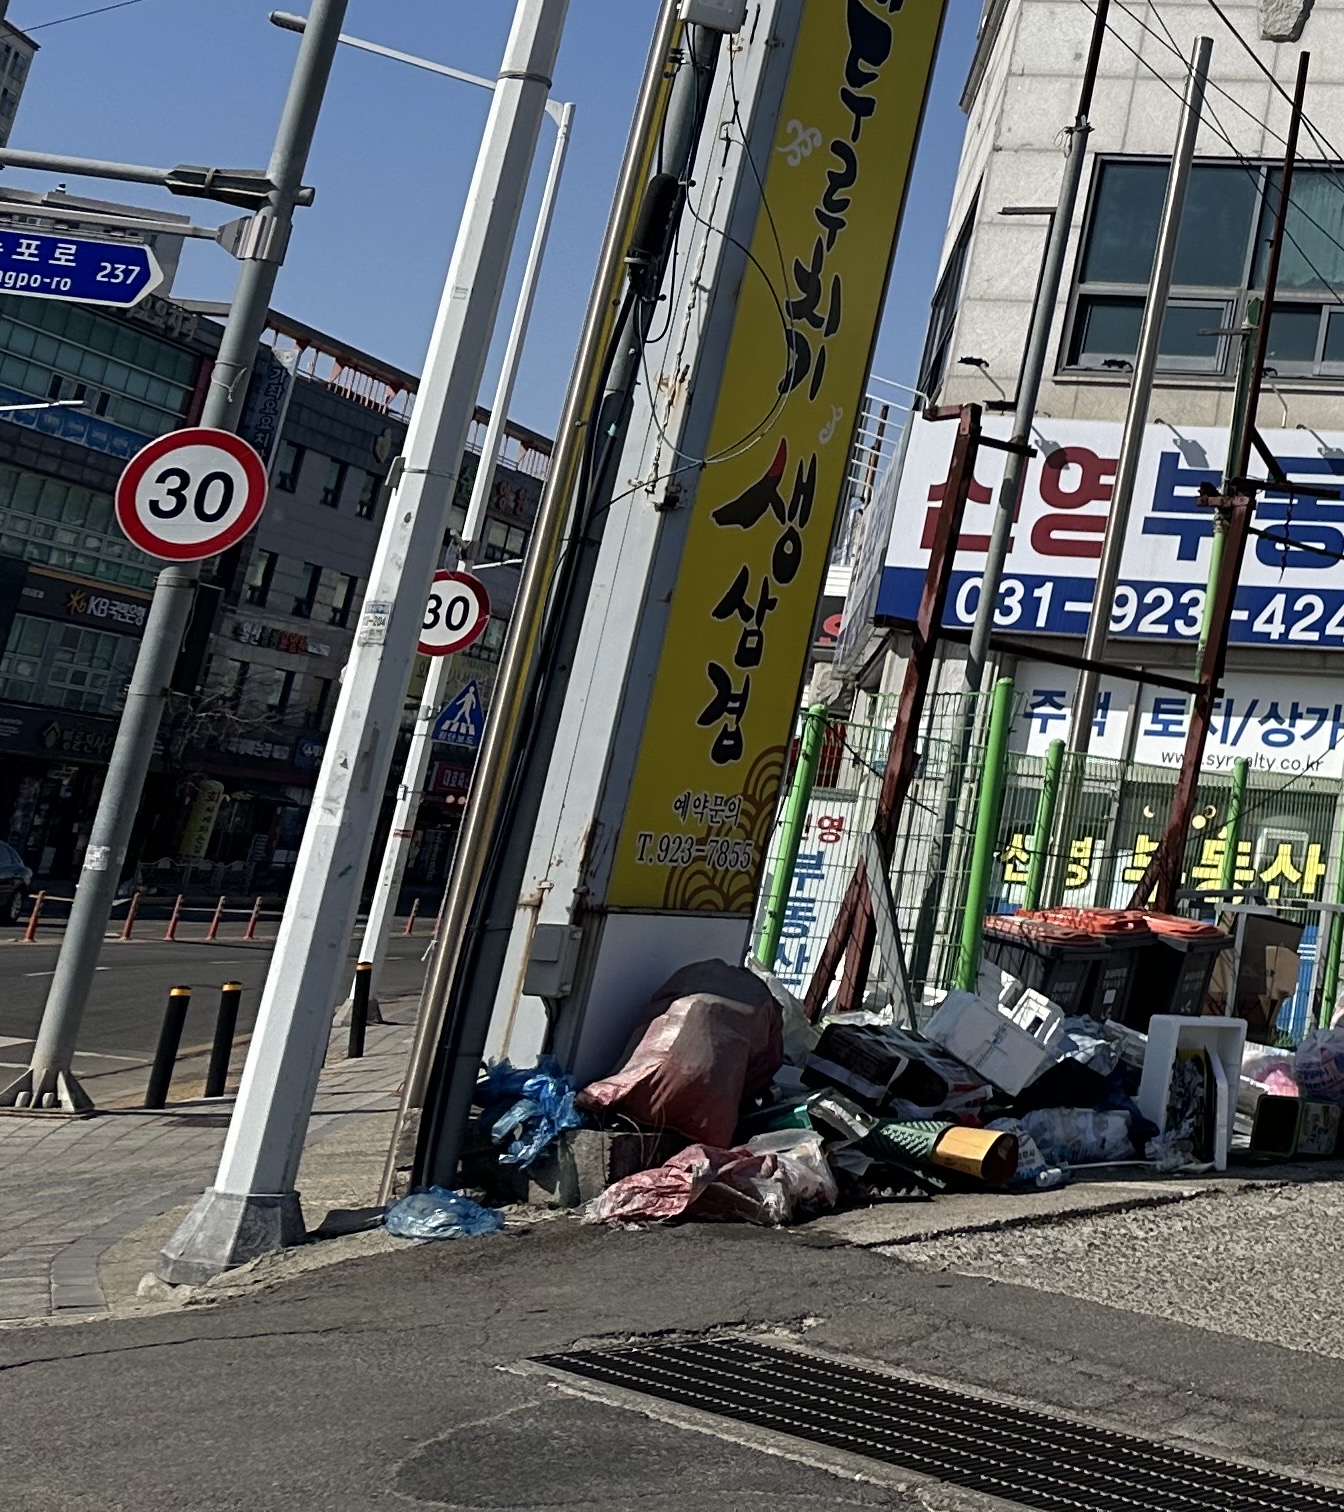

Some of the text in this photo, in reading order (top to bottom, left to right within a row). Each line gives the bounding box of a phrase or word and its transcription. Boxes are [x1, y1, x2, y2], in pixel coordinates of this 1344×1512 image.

[0, 238, 77, 267] 포로
[0, 269, 72, 291] gpo-ro
[96, 262, 141, 285] 237
[148, 466, 235, 522] 30
[919, 445, 1121, 558] 신영
[422, 593, 470, 631] 30
[696, 436, 819, 766] 생삼겹
[1161, 750, 1325, 772] ww.syralty.co.kr
[673, 791, 742, 827] 예약문의
[637, 832, 754, 869] T.923-7855
